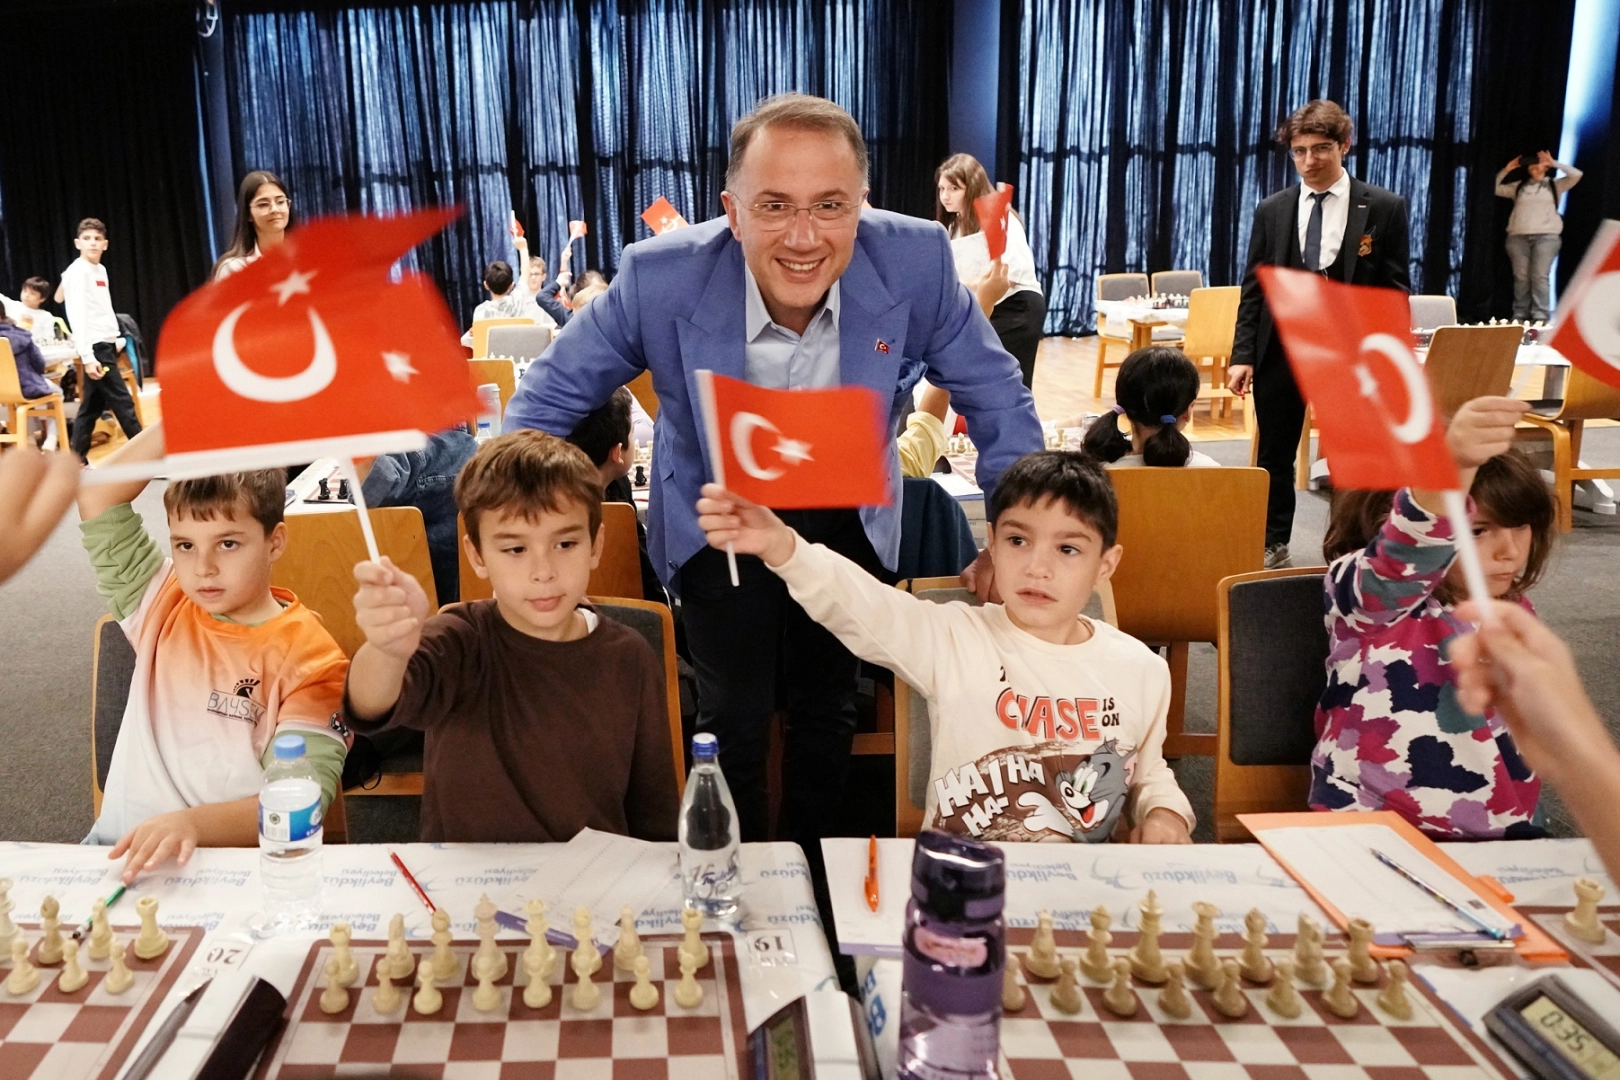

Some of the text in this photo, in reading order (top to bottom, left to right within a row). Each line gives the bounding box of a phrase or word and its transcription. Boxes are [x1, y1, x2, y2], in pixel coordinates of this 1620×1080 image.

[1102, 697, 1115, 712] IS
[1101, 712, 1120, 727] ON
[1007, 753, 1046, 786] HA
[341, 868, 398, 878] Belediyesi
[485, 867, 539, 876] elediyesi
[322, 876, 397, 887] Beylikdüz
[455, 875, 530, 886] eylikdüzü
[754, 935, 784, 953] 19
[206, 947, 243, 965] 20
